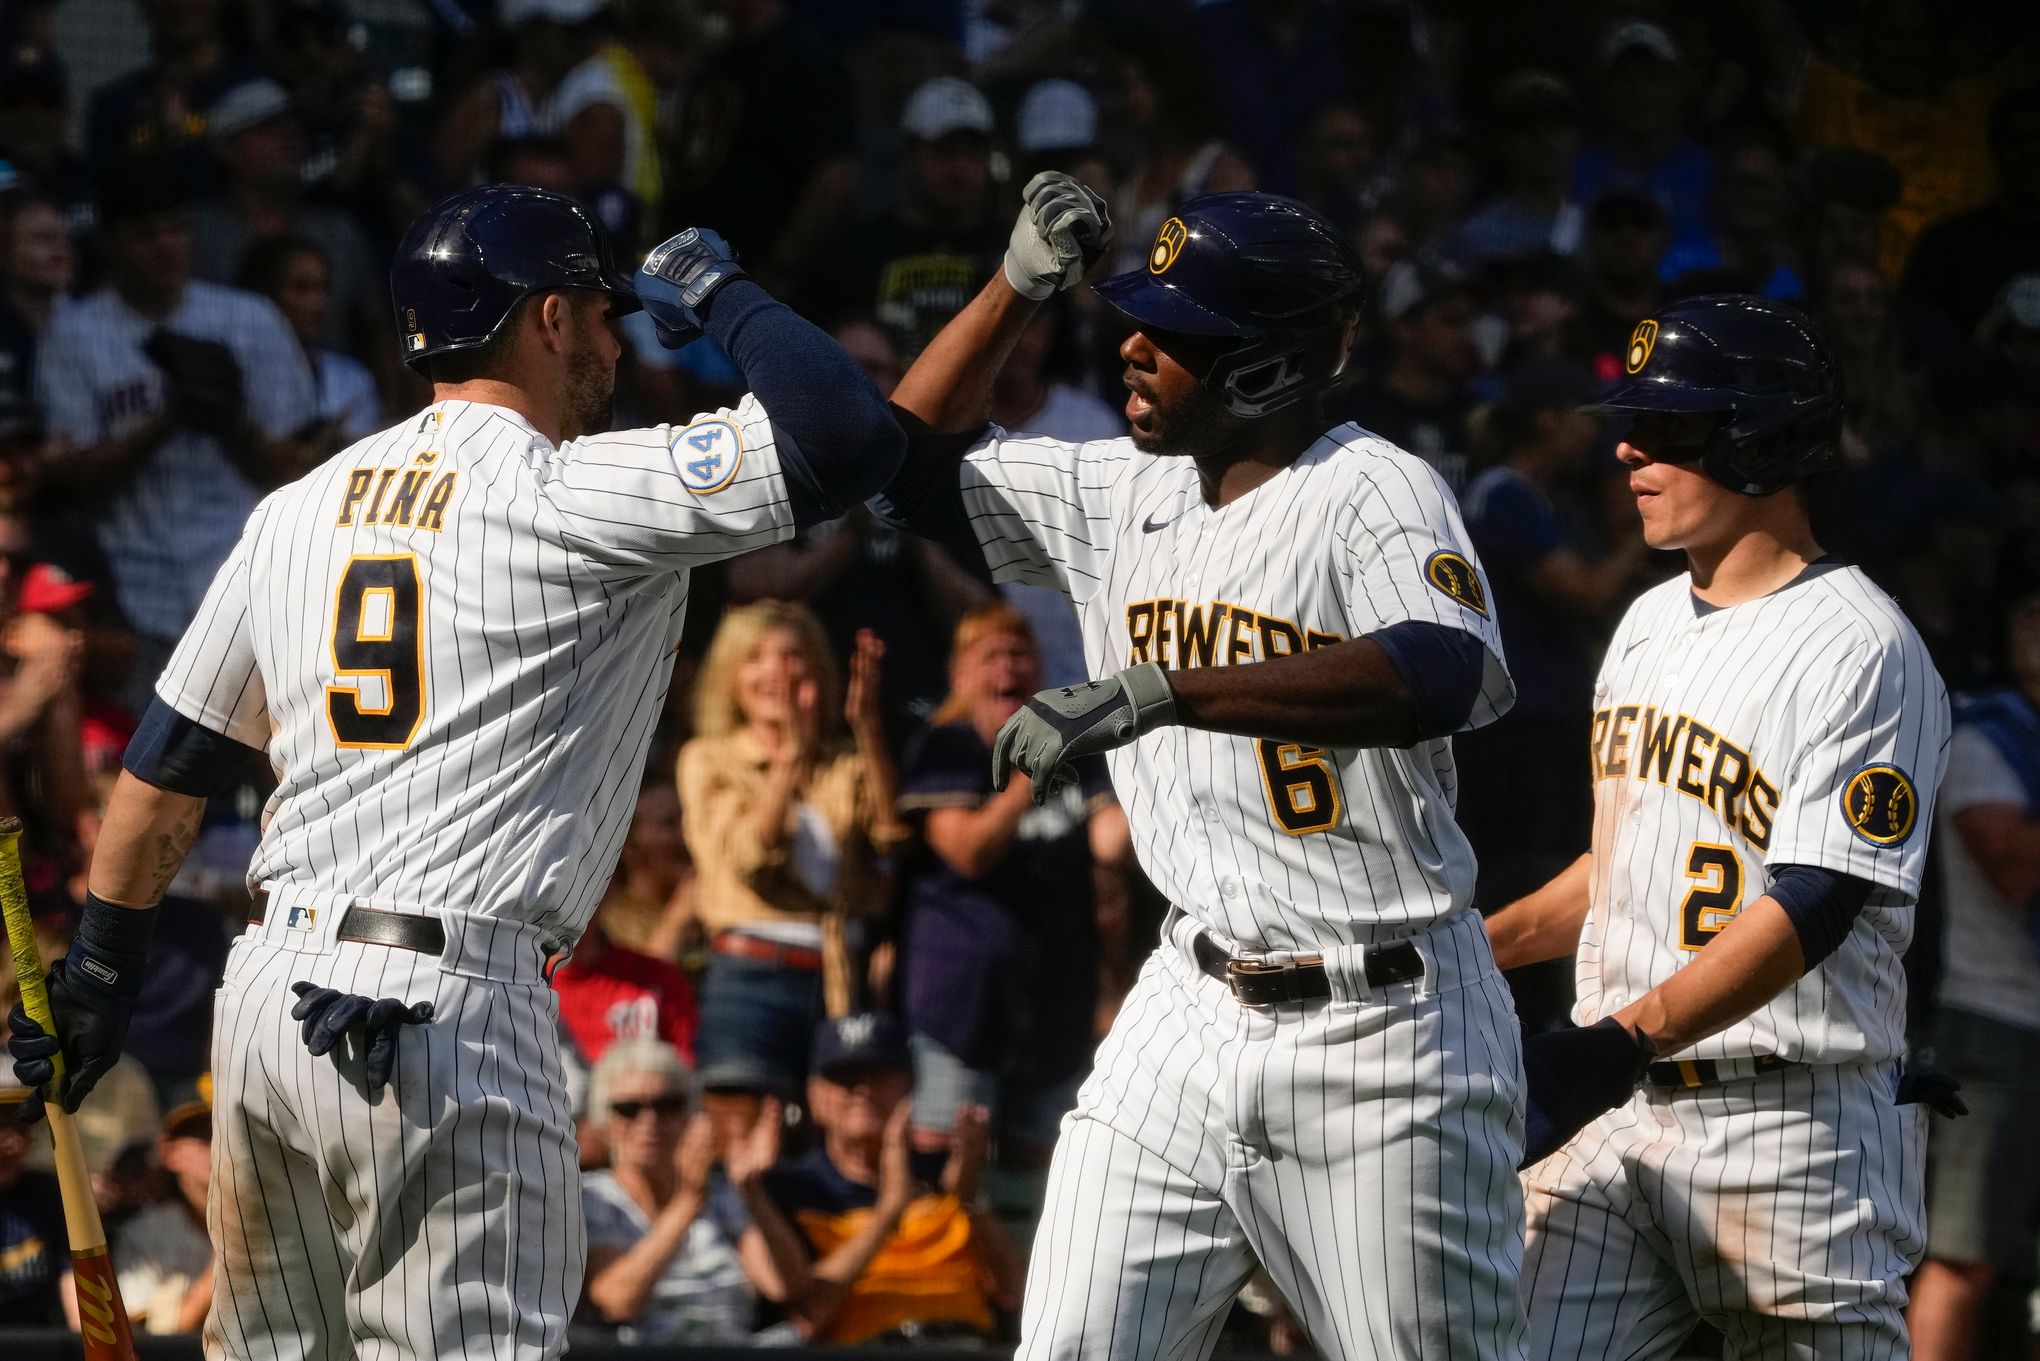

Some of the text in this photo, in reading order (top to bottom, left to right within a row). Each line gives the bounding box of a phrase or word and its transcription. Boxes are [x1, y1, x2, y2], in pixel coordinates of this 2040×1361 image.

[336, 450, 459, 533] PIÑA
[687, 428, 722, 481] 44
[325, 552, 426, 750] 9
[1256, 736, 1341, 836] 6
[1679, 840, 1746, 952] 2
